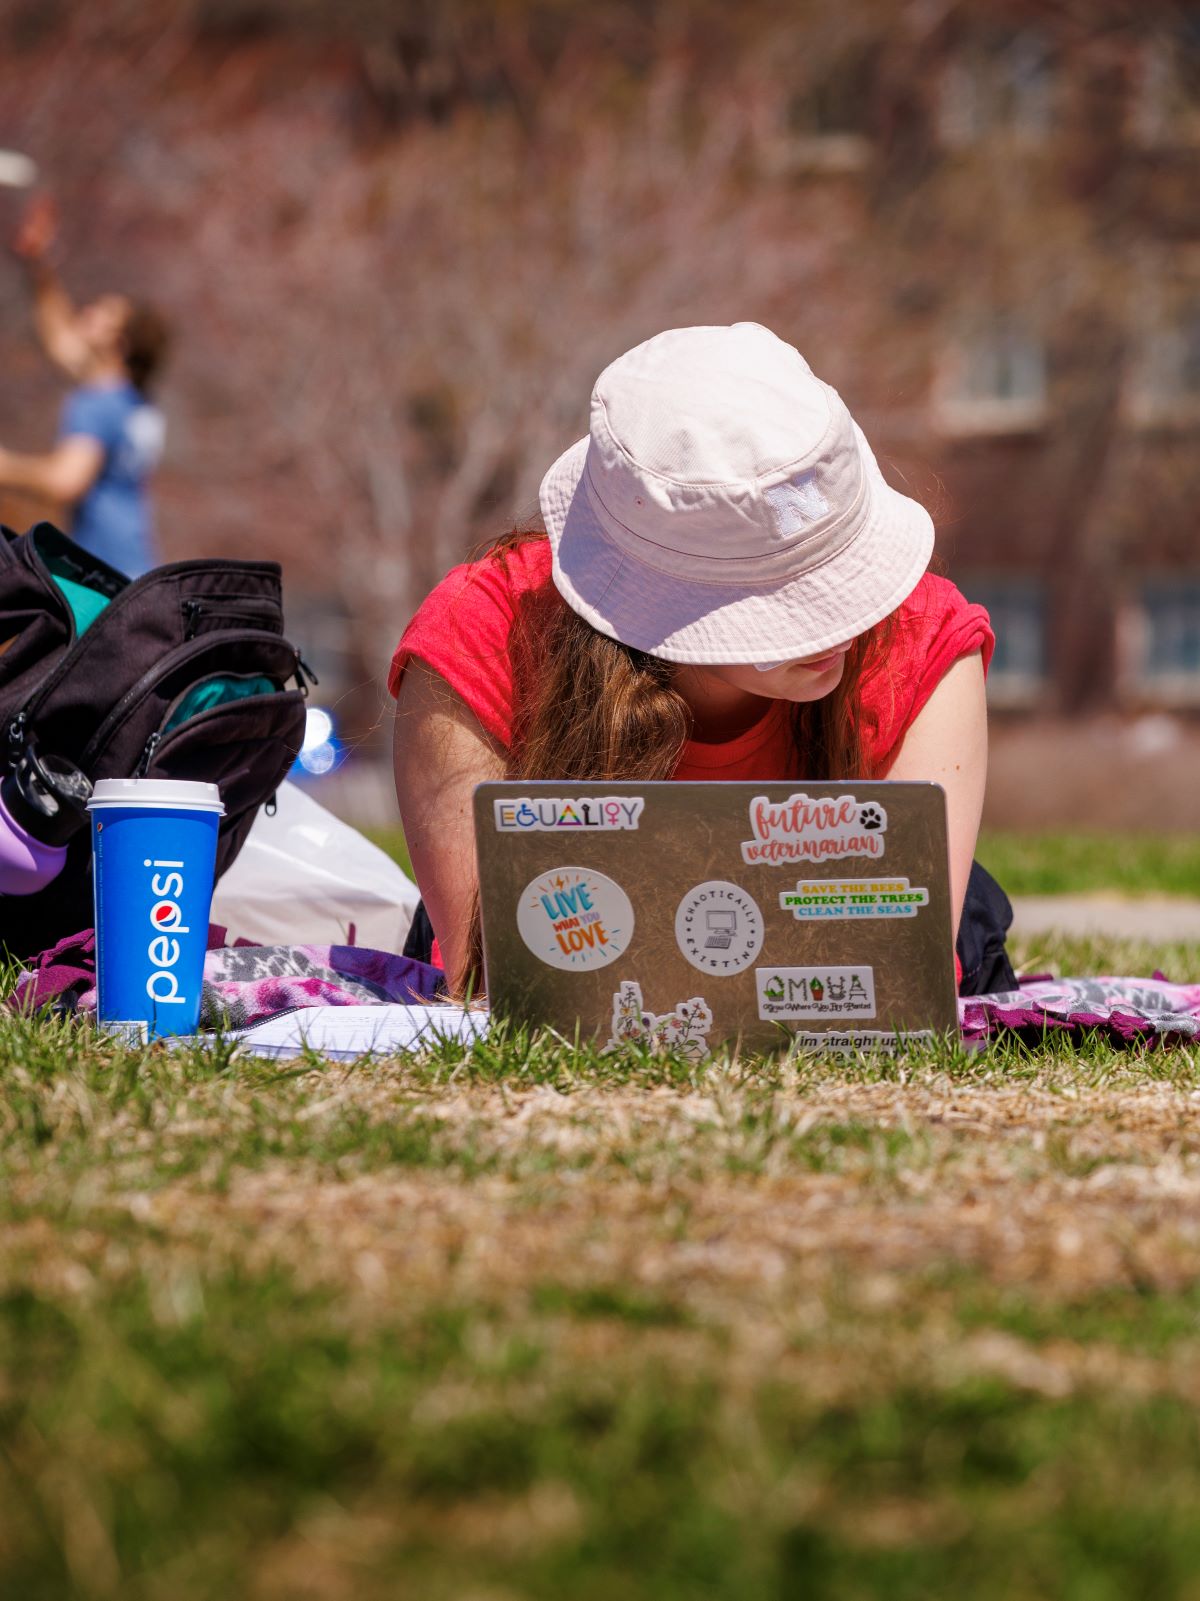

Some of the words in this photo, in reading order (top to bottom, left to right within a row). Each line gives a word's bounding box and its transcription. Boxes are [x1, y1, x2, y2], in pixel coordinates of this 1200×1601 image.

[755, 800, 857, 840] future
[746, 834, 879, 861] veterinarian
[541, 882, 594, 920] LIVE
[785, 895, 845, 906] PROTECT
[850, 894, 878, 904] THE
[879, 893, 924, 903] TREES
[801, 884, 836, 894] SAVE
[841, 884, 869, 893] THE
[870, 883, 905, 893] BEES
[685, 890, 756, 925] CHAOTICALLY
[798, 906, 843, 916] CLEAN
[848, 905, 876, 915] THE
[877, 905, 912, 915] SEAS
[143, 859, 190, 1004] pepsi
[552, 917, 580, 932] WHAT
[580, 912, 600, 924] YOU
[556, 921, 609, 955] LOVE
[686, 938, 755, 968] EXISTING
[800, 1036, 817, 1046] im
